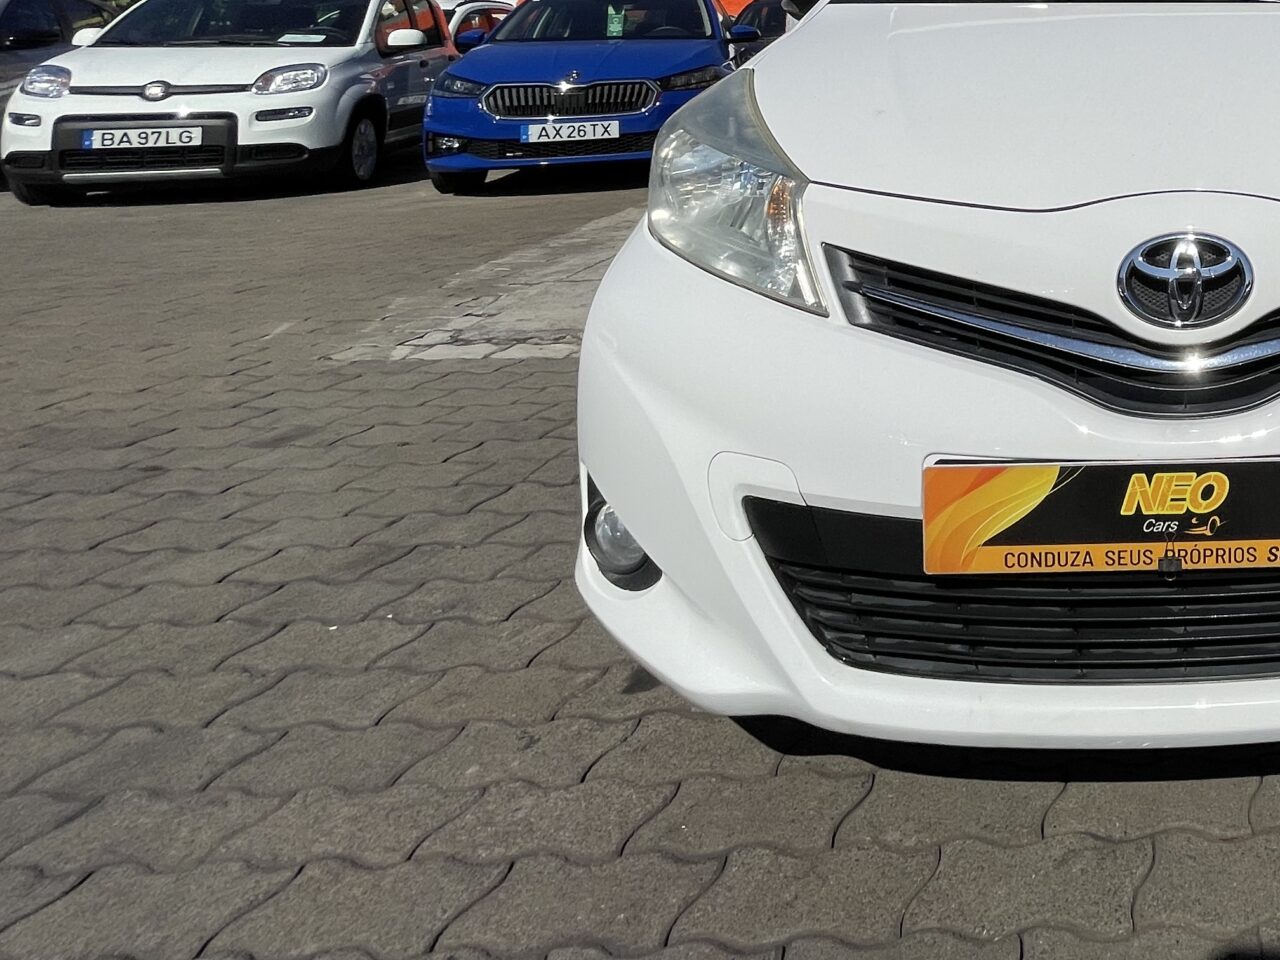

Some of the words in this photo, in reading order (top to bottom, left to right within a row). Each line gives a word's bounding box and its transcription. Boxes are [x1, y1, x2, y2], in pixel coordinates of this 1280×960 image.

[1120, 471, 1230, 515] NEO
[1142, 518, 1180, 533] Cars
[1004, 550, 1094, 568] CONDUZA
[1105, 548, 1153, 566] SEUS
